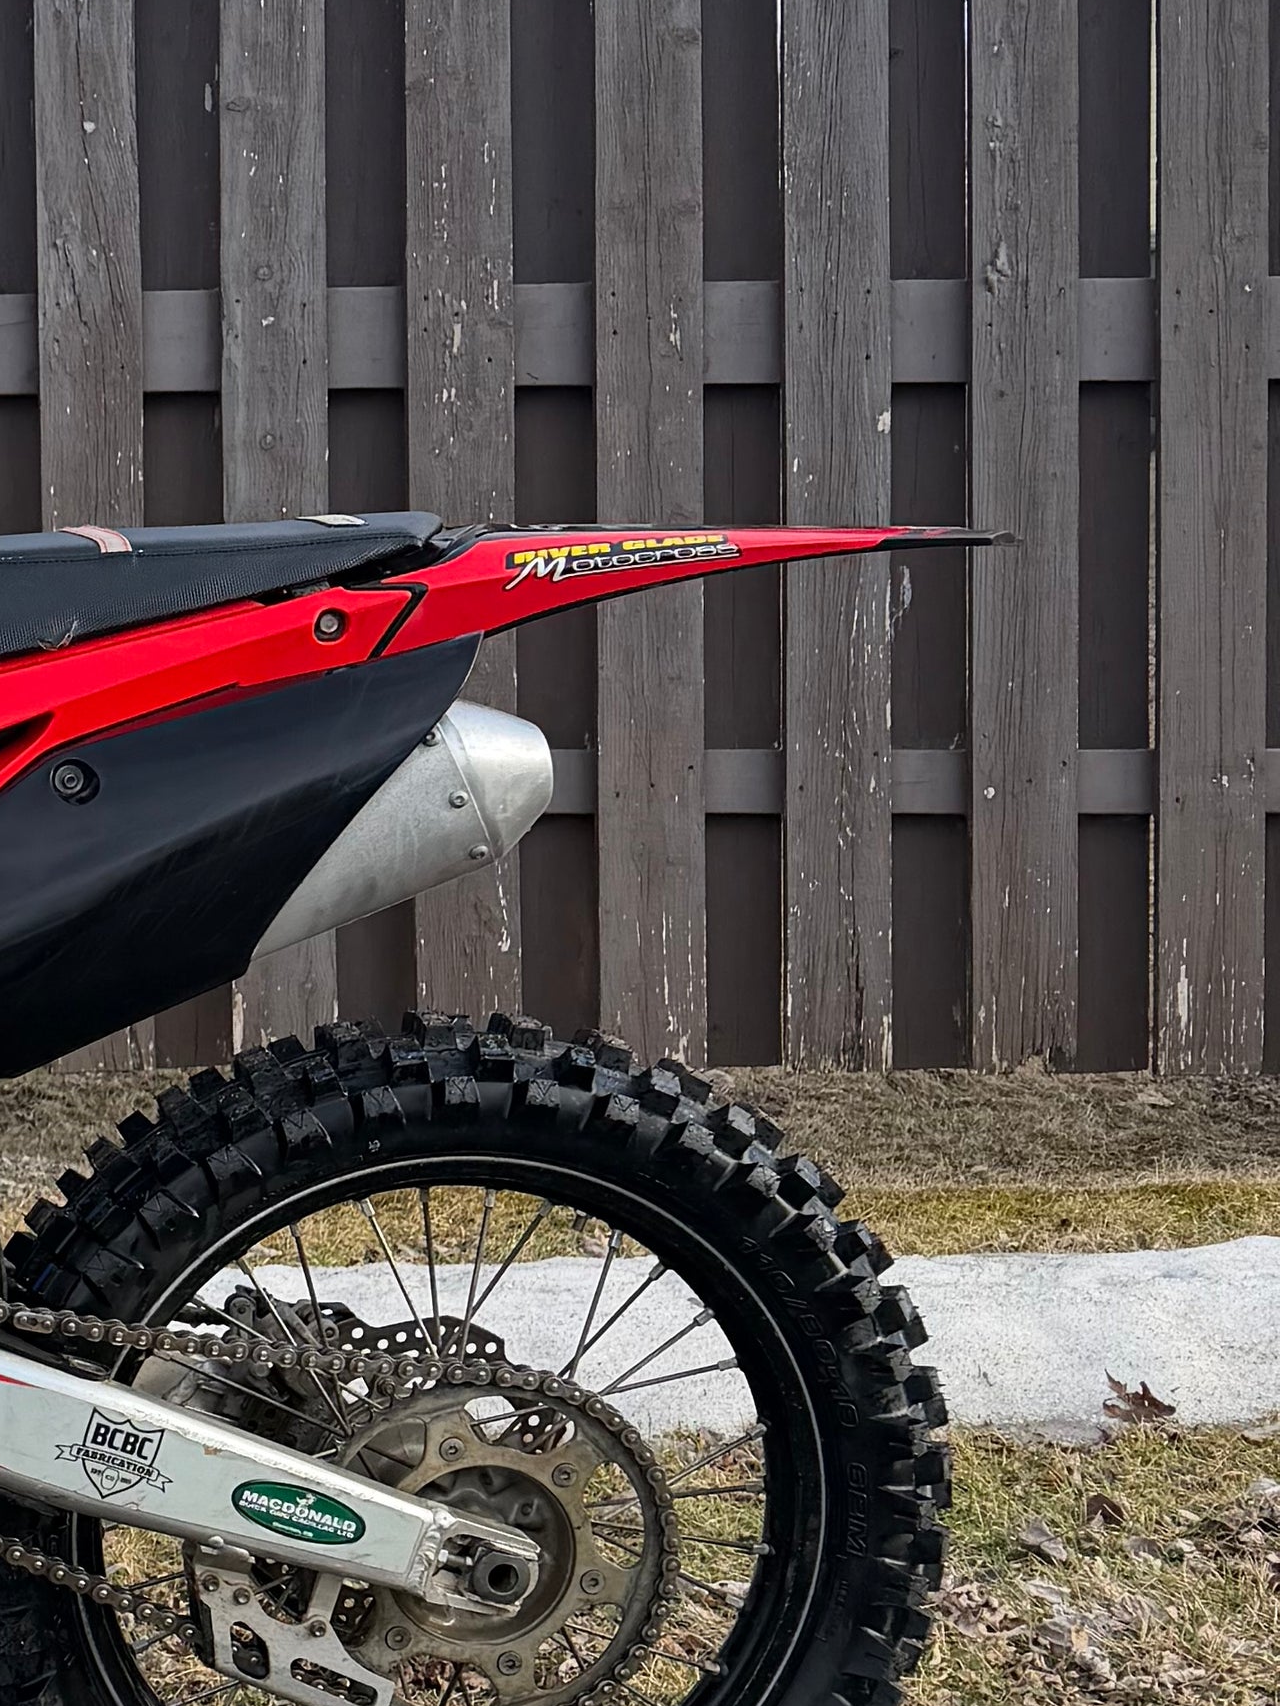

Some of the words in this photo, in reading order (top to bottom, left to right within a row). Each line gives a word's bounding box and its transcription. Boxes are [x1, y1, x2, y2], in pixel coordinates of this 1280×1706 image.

[505, 542, 740, 590] Motocross
[513, 542, 612, 565] RIVER
[622, 534, 726, 550] GLADE
[90, 1422, 154, 1461] BCBC
[75, 1447, 155, 1478] FABRICATION
[242, 1490, 357, 1532] MACDONALD
